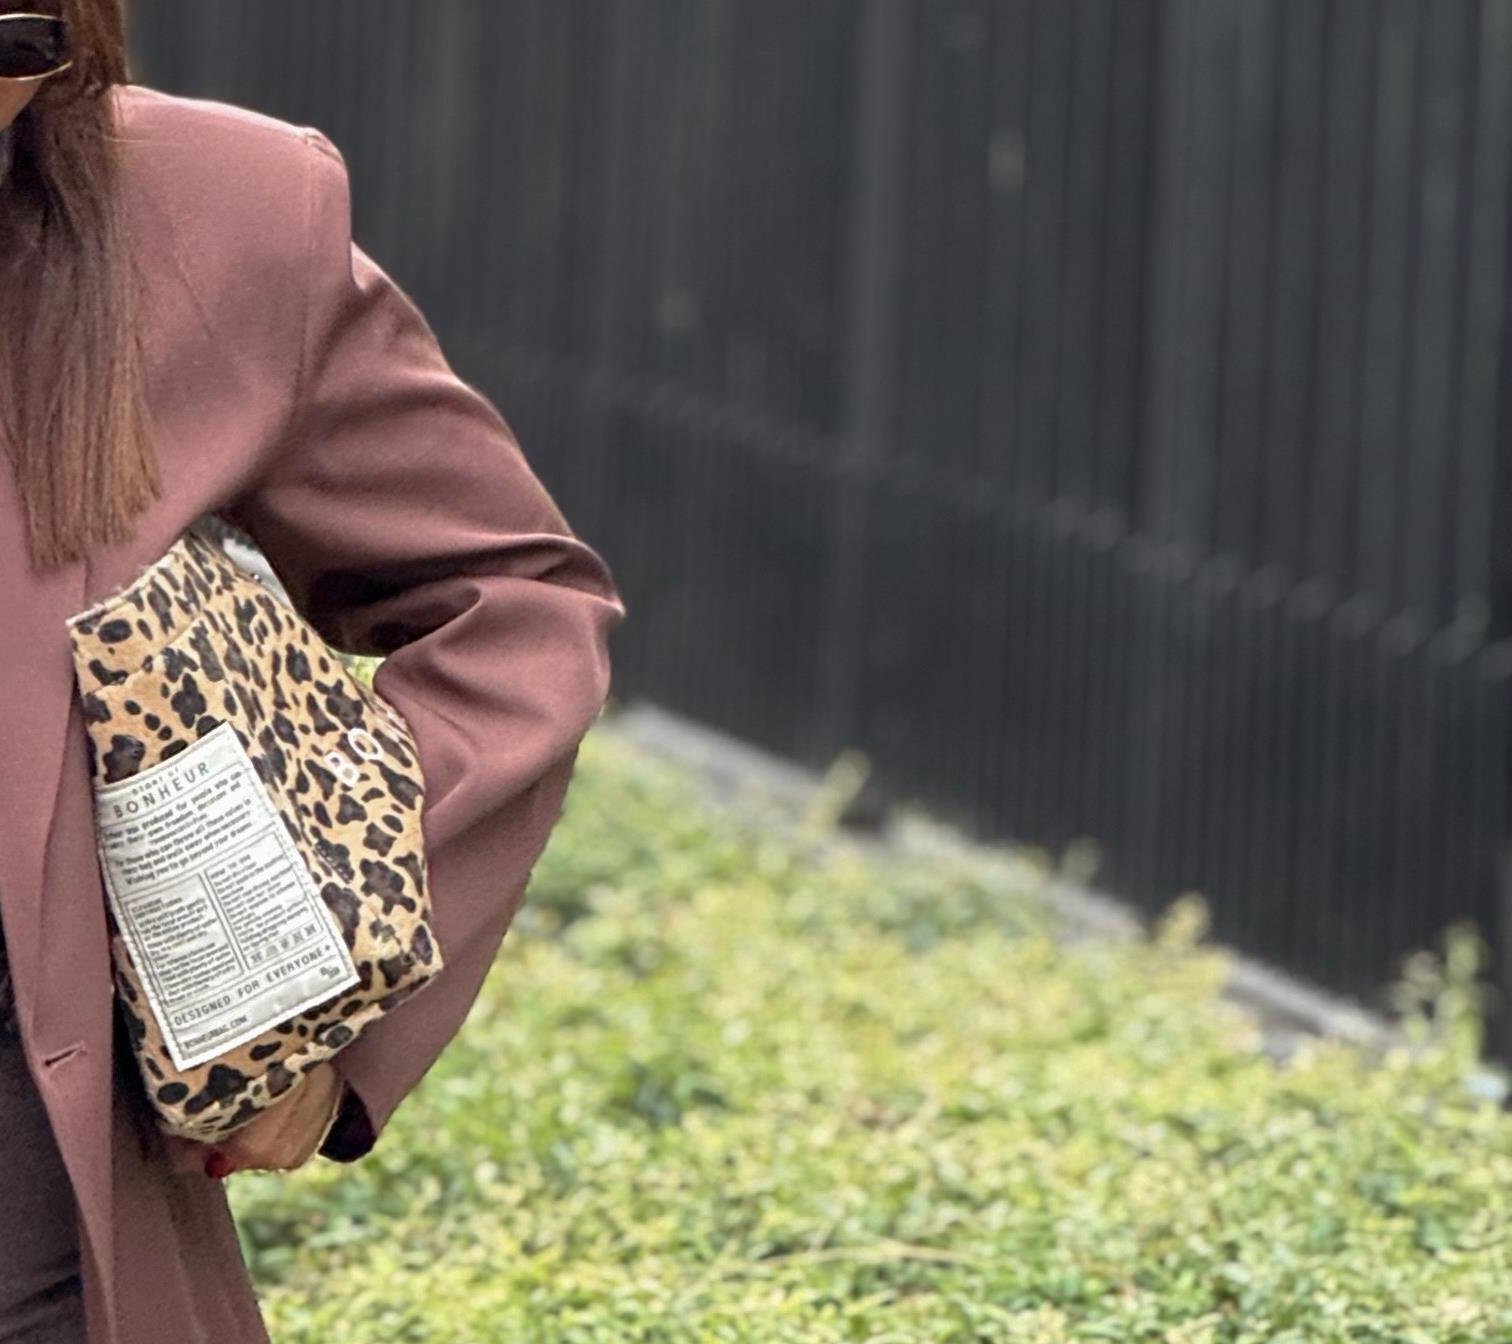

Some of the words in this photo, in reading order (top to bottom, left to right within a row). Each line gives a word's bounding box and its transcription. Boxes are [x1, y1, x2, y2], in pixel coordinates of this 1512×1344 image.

[113, 761, 210, 819] BONHEUR
[174, 994, 232, 1027] DESIGNED
[236, 979, 261, 997] FOR
[266, 949, 324, 981] EVERYONE
